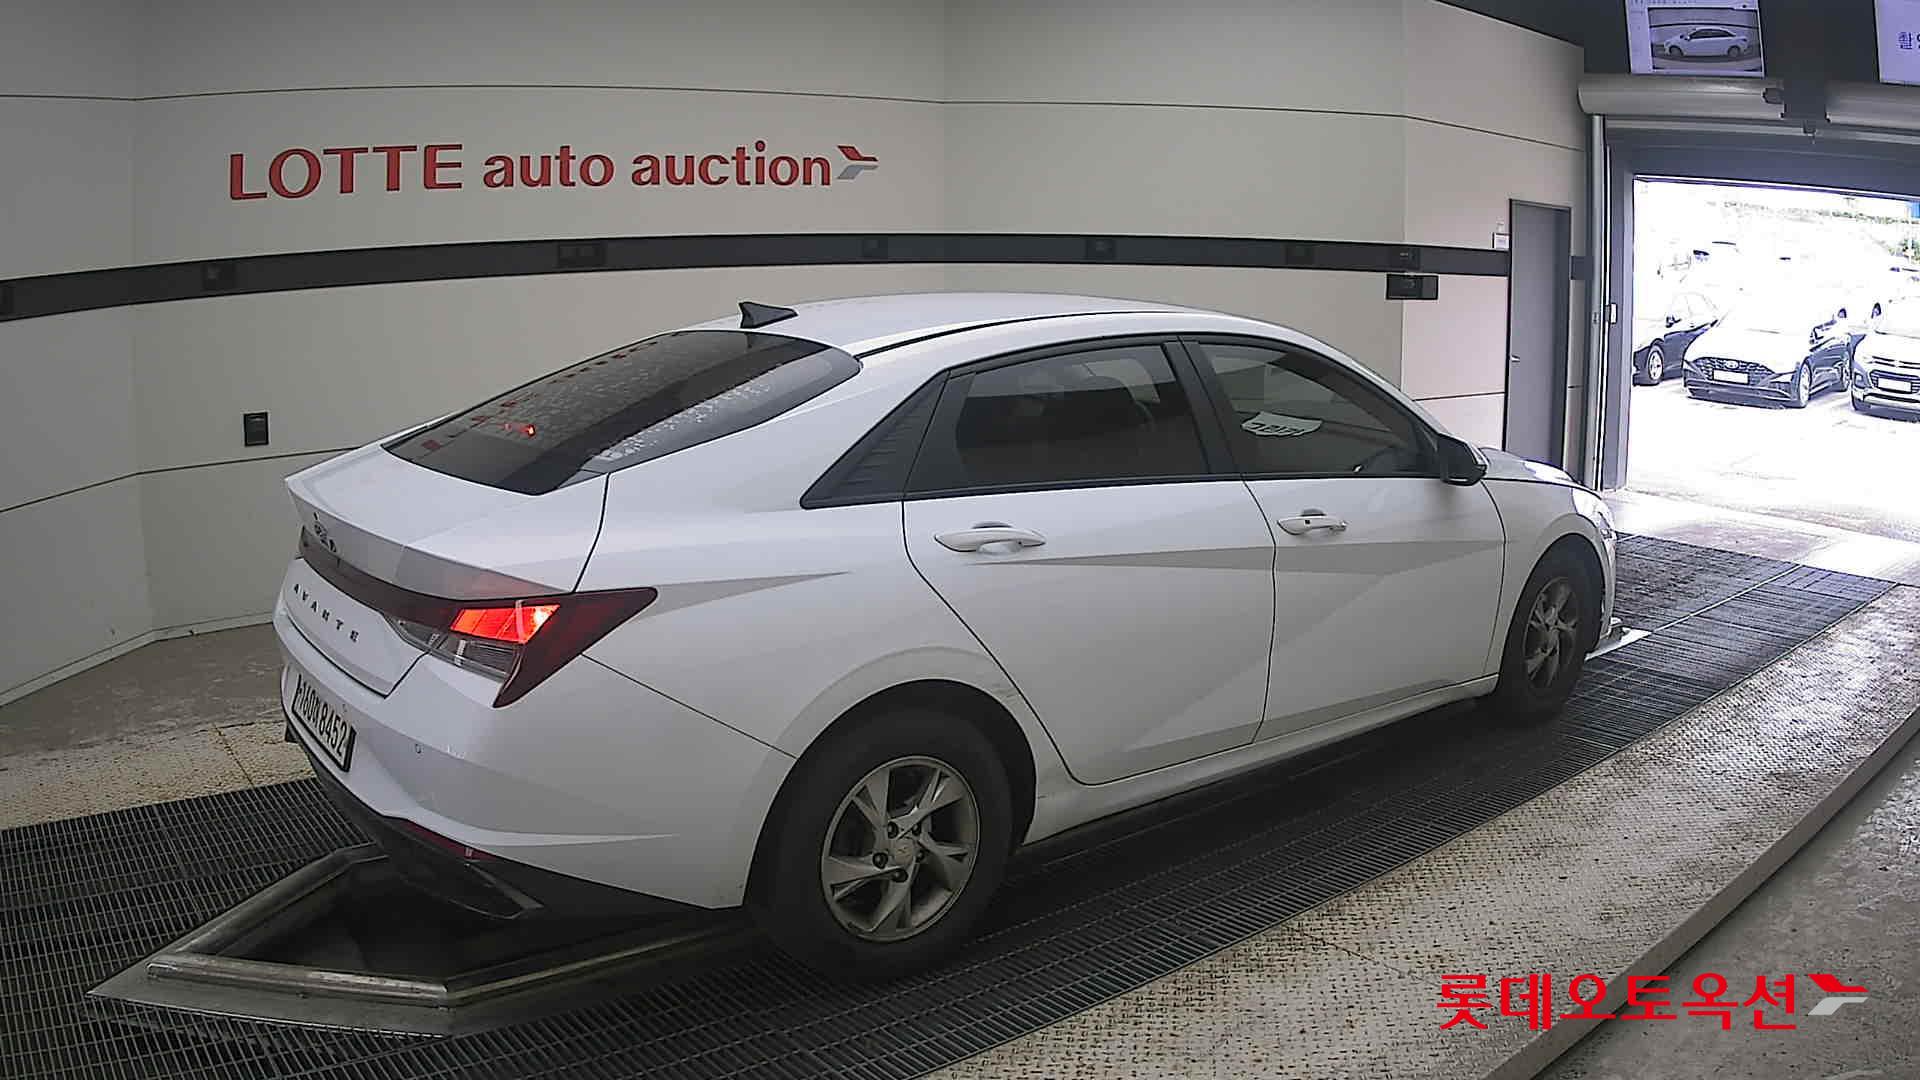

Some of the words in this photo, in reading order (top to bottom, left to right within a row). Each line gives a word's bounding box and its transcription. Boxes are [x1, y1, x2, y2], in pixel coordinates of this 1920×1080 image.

[230, 144, 463, 199] LOTTE
[483, 145, 614, 188] auto
[631, 141, 831, 186] auction
[293, 583, 359, 642] AVANTE
